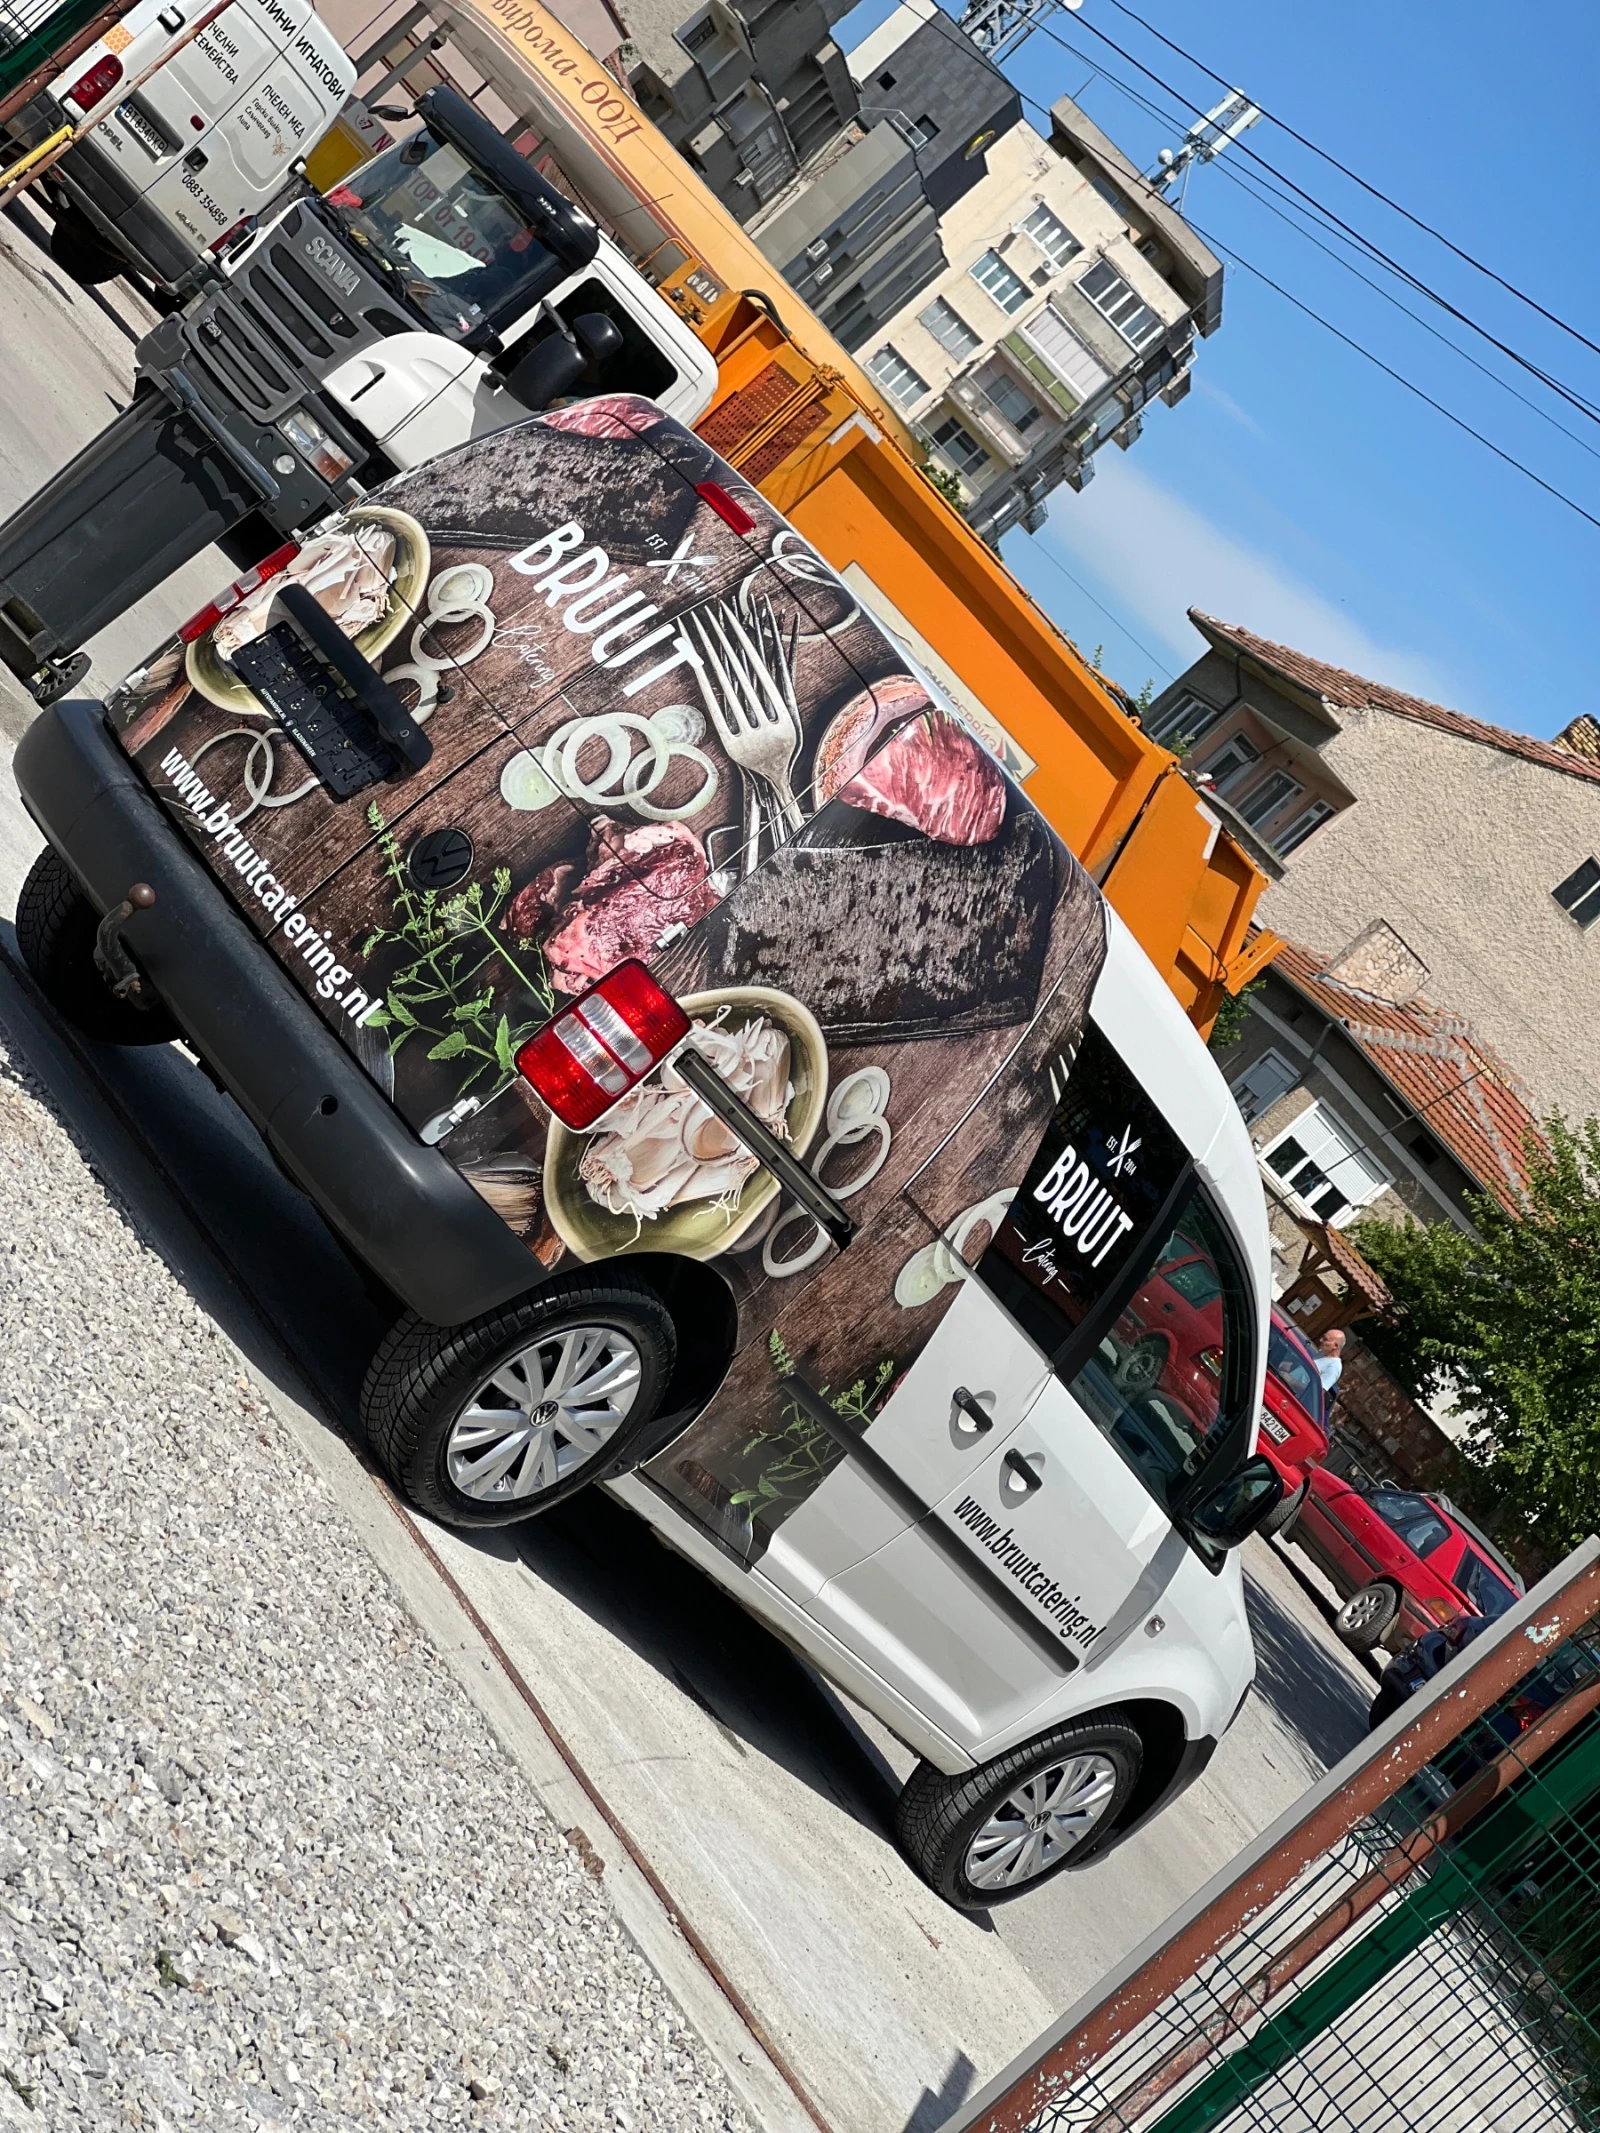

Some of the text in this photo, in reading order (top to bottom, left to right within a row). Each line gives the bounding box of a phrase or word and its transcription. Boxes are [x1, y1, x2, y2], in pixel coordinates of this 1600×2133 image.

[294, 35, 346, 101] ИГНАТОВИ
[97, 121, 124, 153] OPEL
[261, 84, 306, 140] ПЧЕЛЕН МЕД
[181, 174, 204, 197] 0883
[199, 194, 228, 226] 354858
[305, 236, 361, 297] SCANIA
[645, 533, 668, 554] EST.
[508, 520, 705, 697] BRUUT
[159, 746, 385, 1029] www.bruutcatering.nl
[1105, 1134, 1119, 1154] EST.
[1033, 1144, 1134, 1269] BRUUT
[953, 1495, 1107, 1649] www.bruutcatering.nl
